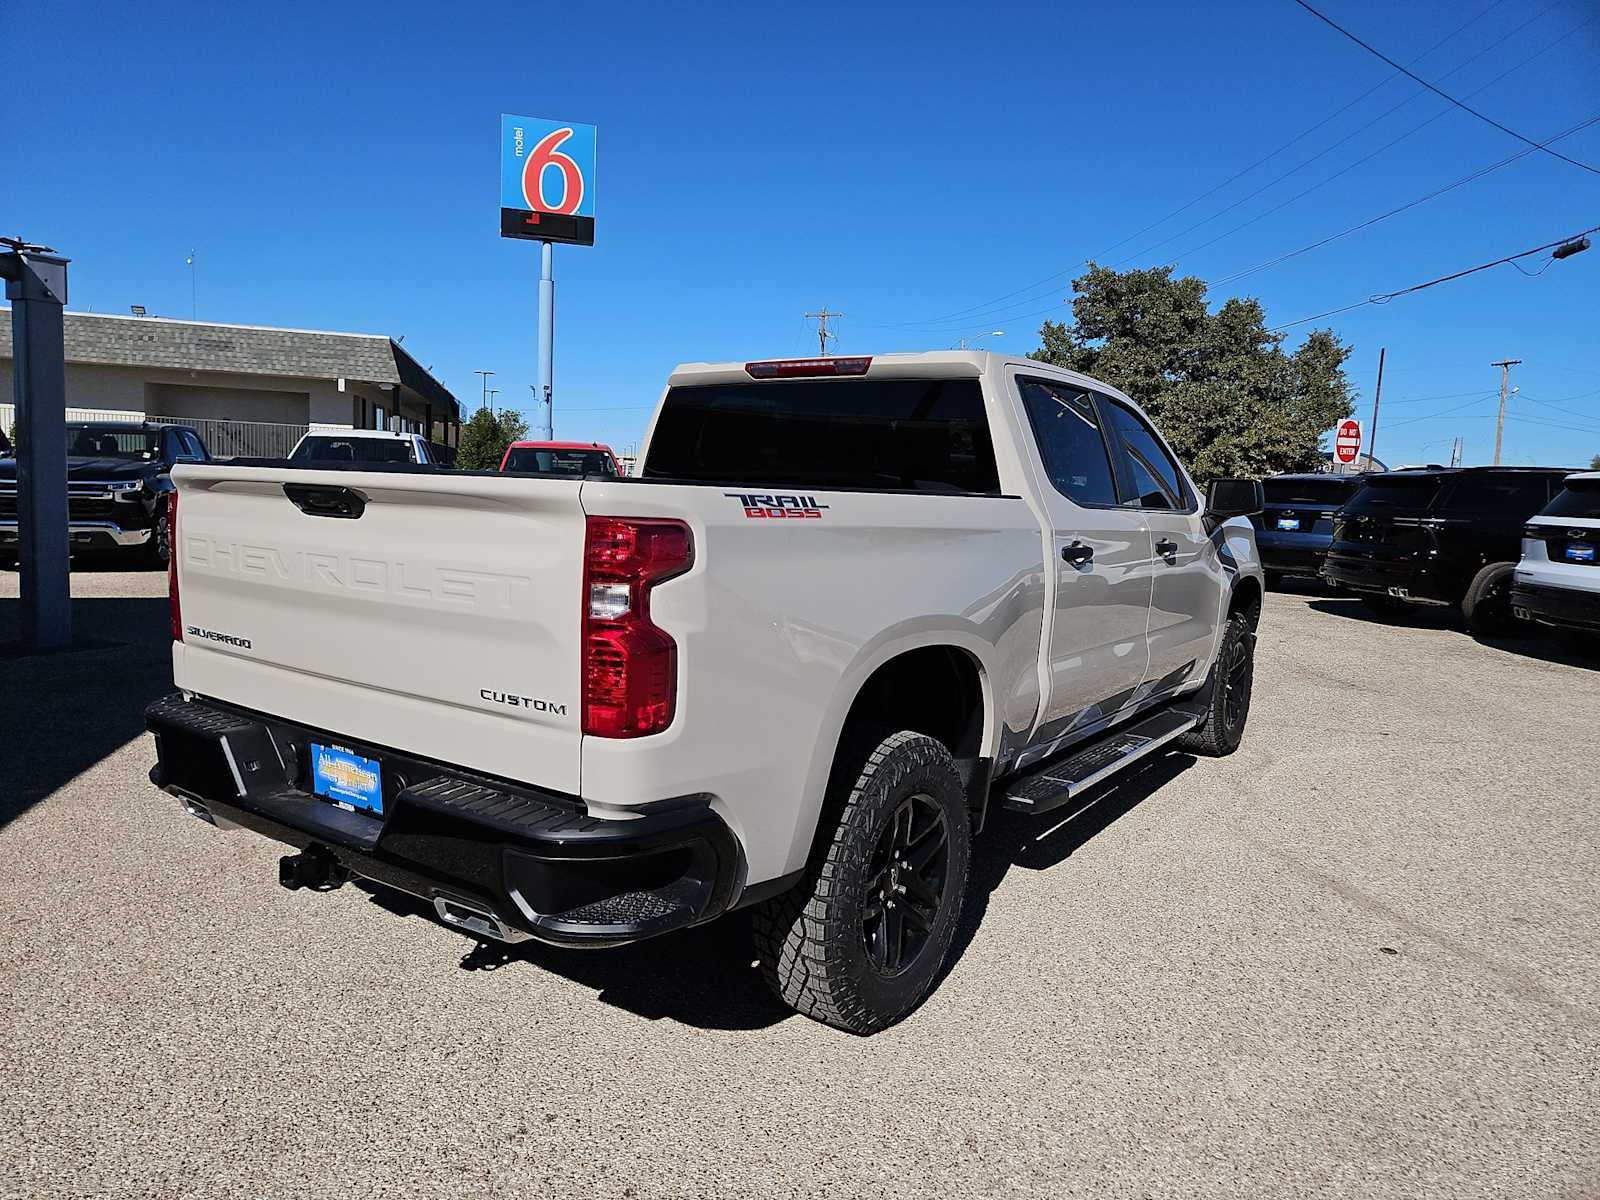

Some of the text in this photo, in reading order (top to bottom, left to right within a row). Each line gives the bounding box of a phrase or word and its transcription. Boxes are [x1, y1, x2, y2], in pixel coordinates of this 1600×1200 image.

[514, 127, 584, 215] motel 6
[724, 493, 830, 509] TRAIL
[743, 507, 822, 519] BOSS
[184, 536, 531, 609] CHEVROLET
[187, 625, 252, 650] SILVERADO
[480, 688, 568, 716] CUSTOM
